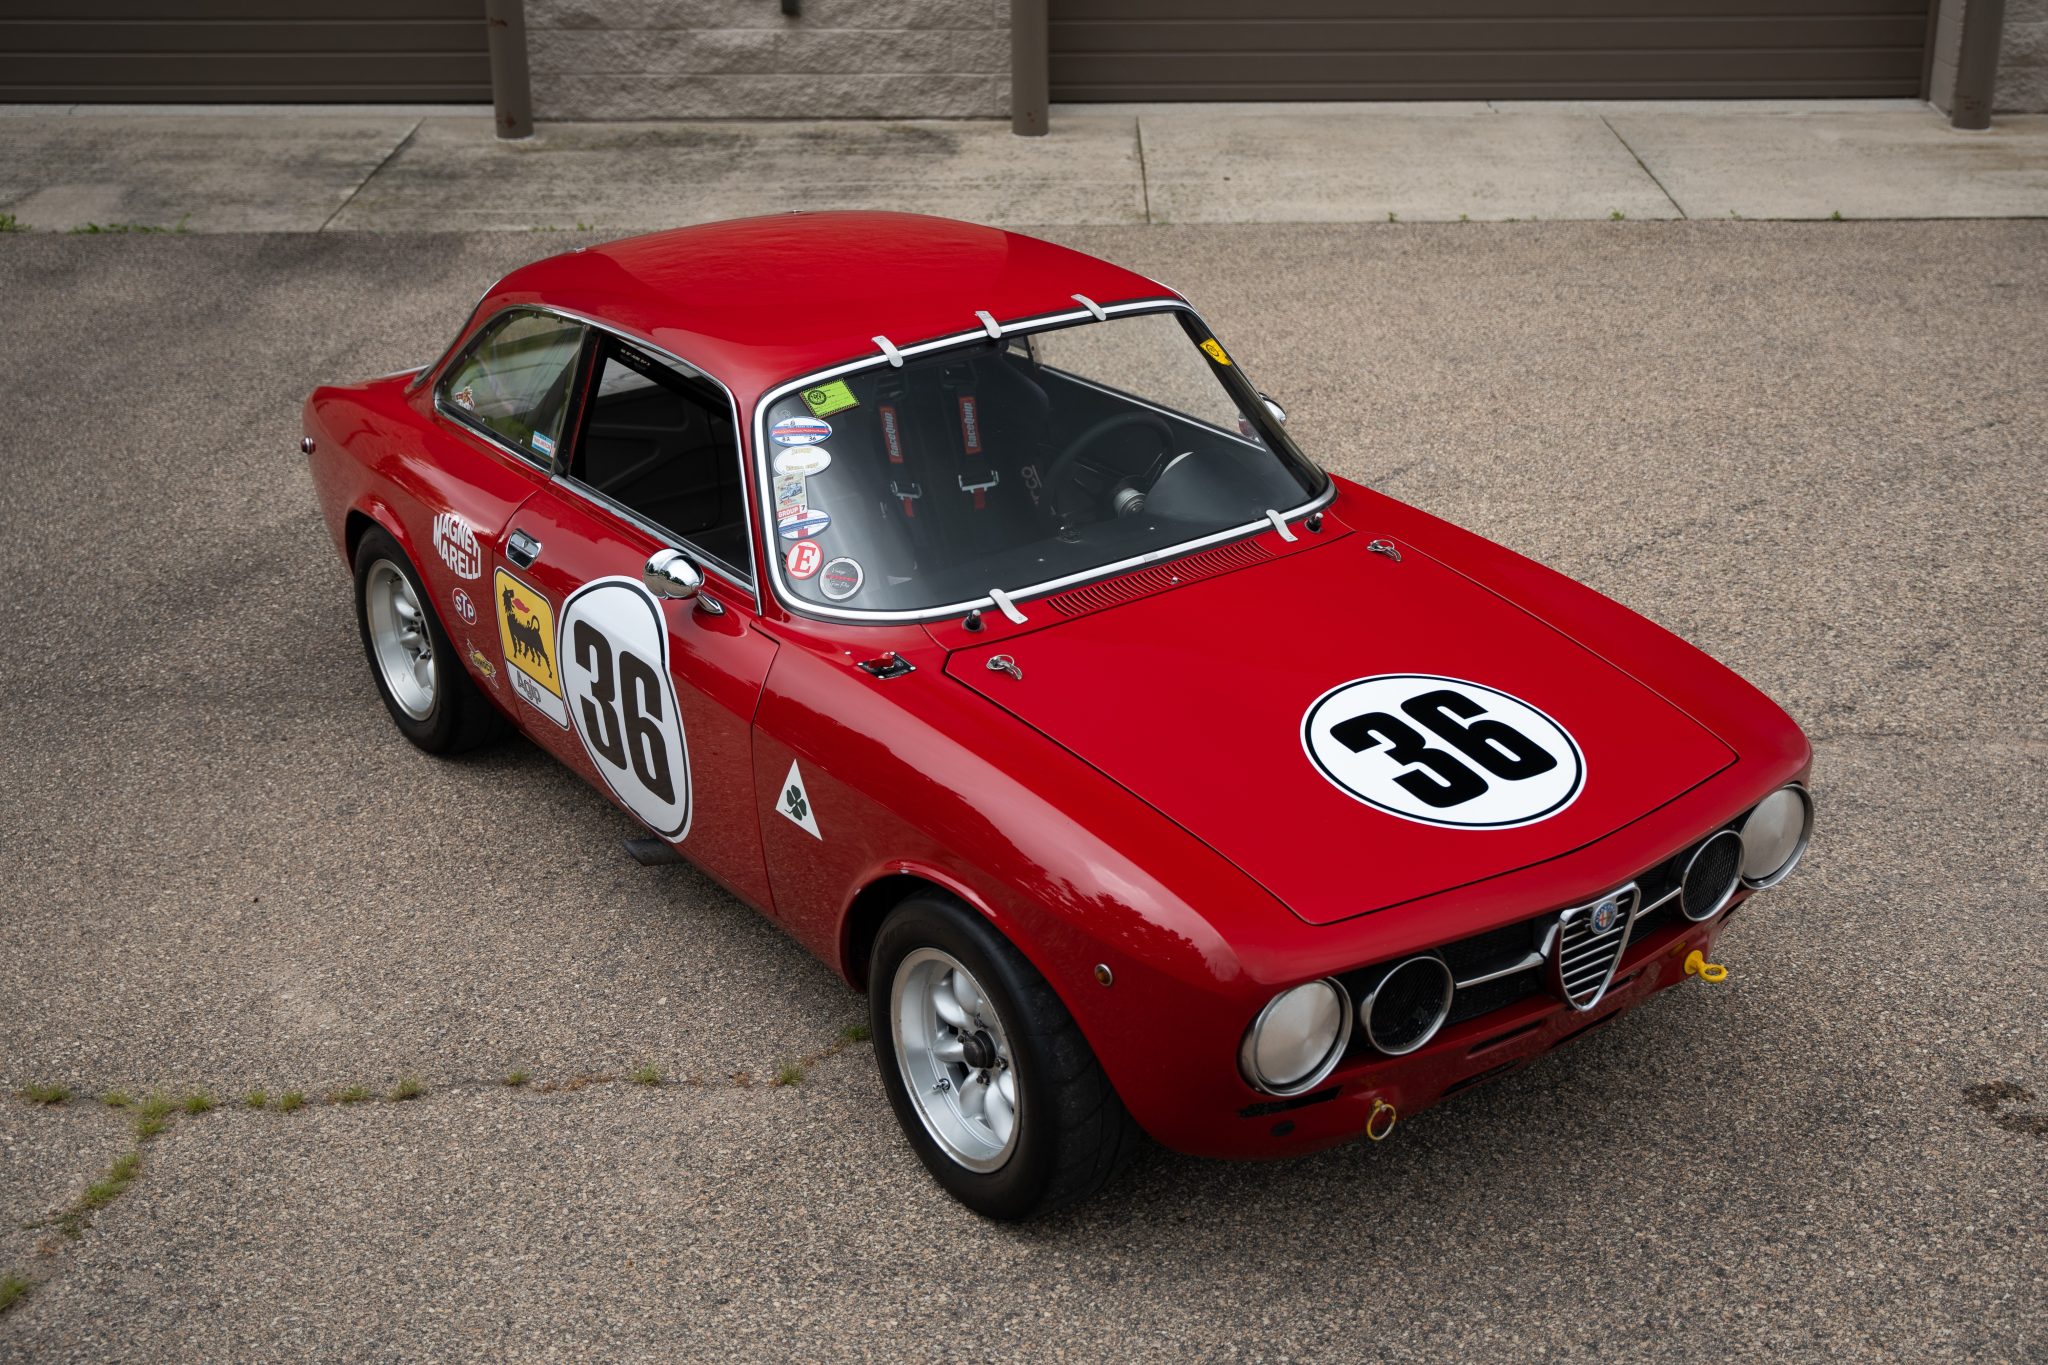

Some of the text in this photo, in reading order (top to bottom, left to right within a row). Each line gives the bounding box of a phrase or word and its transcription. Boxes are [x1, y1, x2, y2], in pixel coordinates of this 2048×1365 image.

[778, 506, 799, 518] GROUP
[433, 530, 481, 579] MARELLI
[792, 545, 816, 573] E
[455, 592, 474, 618] STP
[517, 670, 541, 705] Agip
[573, 619, 676, 806] 36
[1329, 689, 1558, 808] 36
